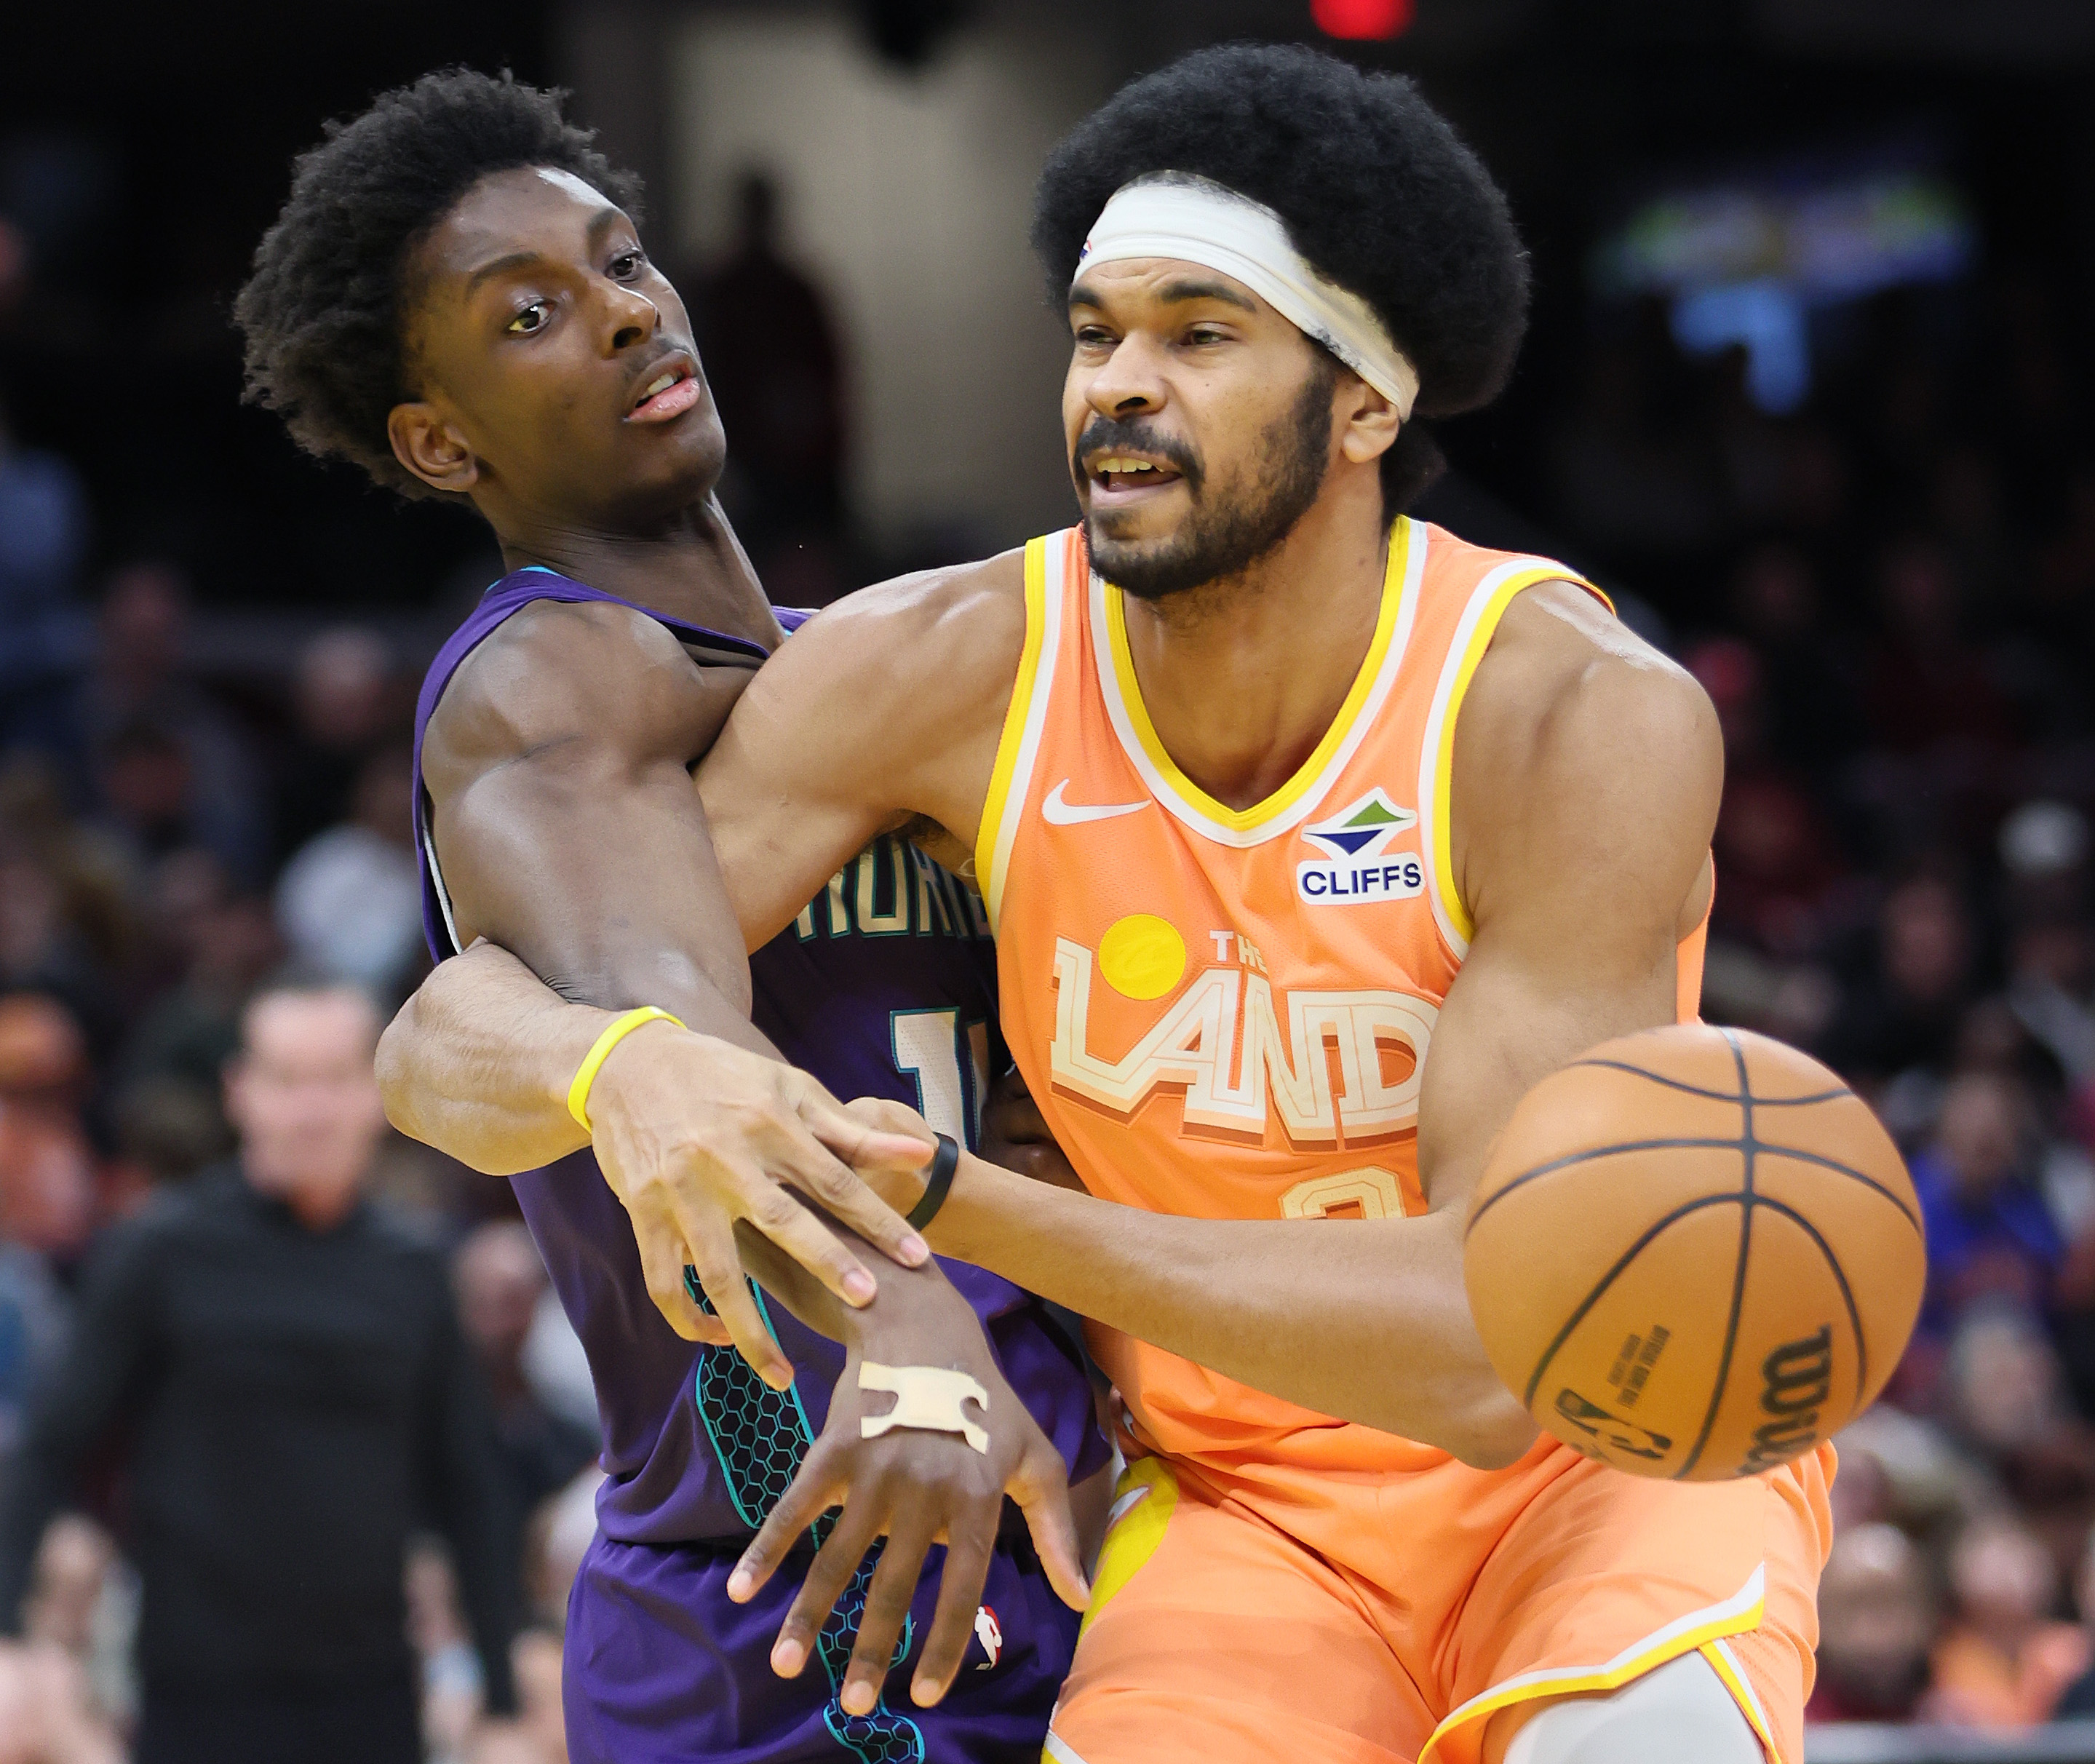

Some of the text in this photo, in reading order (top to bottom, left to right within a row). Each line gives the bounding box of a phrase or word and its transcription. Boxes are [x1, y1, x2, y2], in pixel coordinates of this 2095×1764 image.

[1301, 862, 1422, 896] CLIFFS
[1209, 929, 1269, 977] THE
[1050, 935, 1440, 1153] LAND
